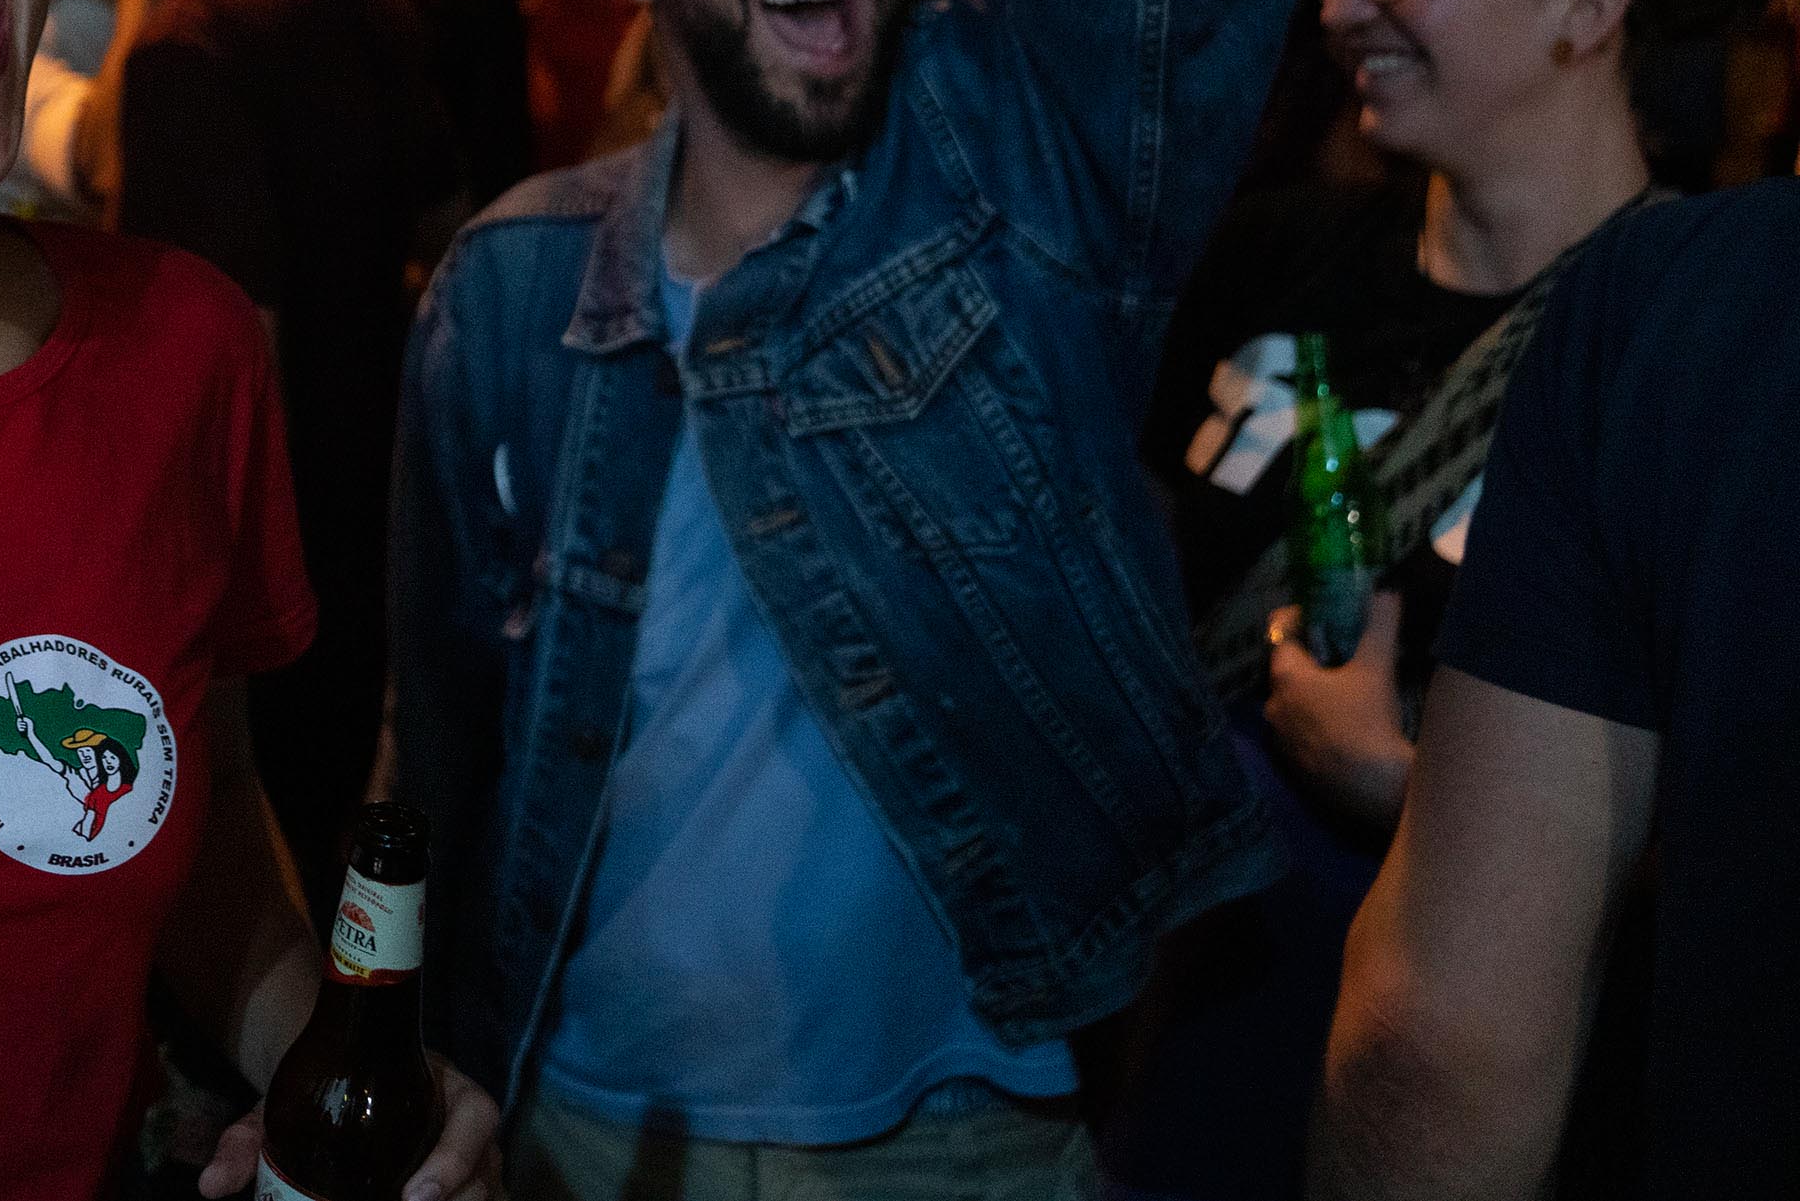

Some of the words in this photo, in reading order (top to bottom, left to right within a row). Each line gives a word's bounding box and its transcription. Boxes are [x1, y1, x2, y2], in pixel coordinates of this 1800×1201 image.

[111, 668, 162, 719] RURAIS
[157, 723, 173, 765] SEM
[148, 767, 175, 826] TERRA
[47, 852, 110, 868] BRASIL
